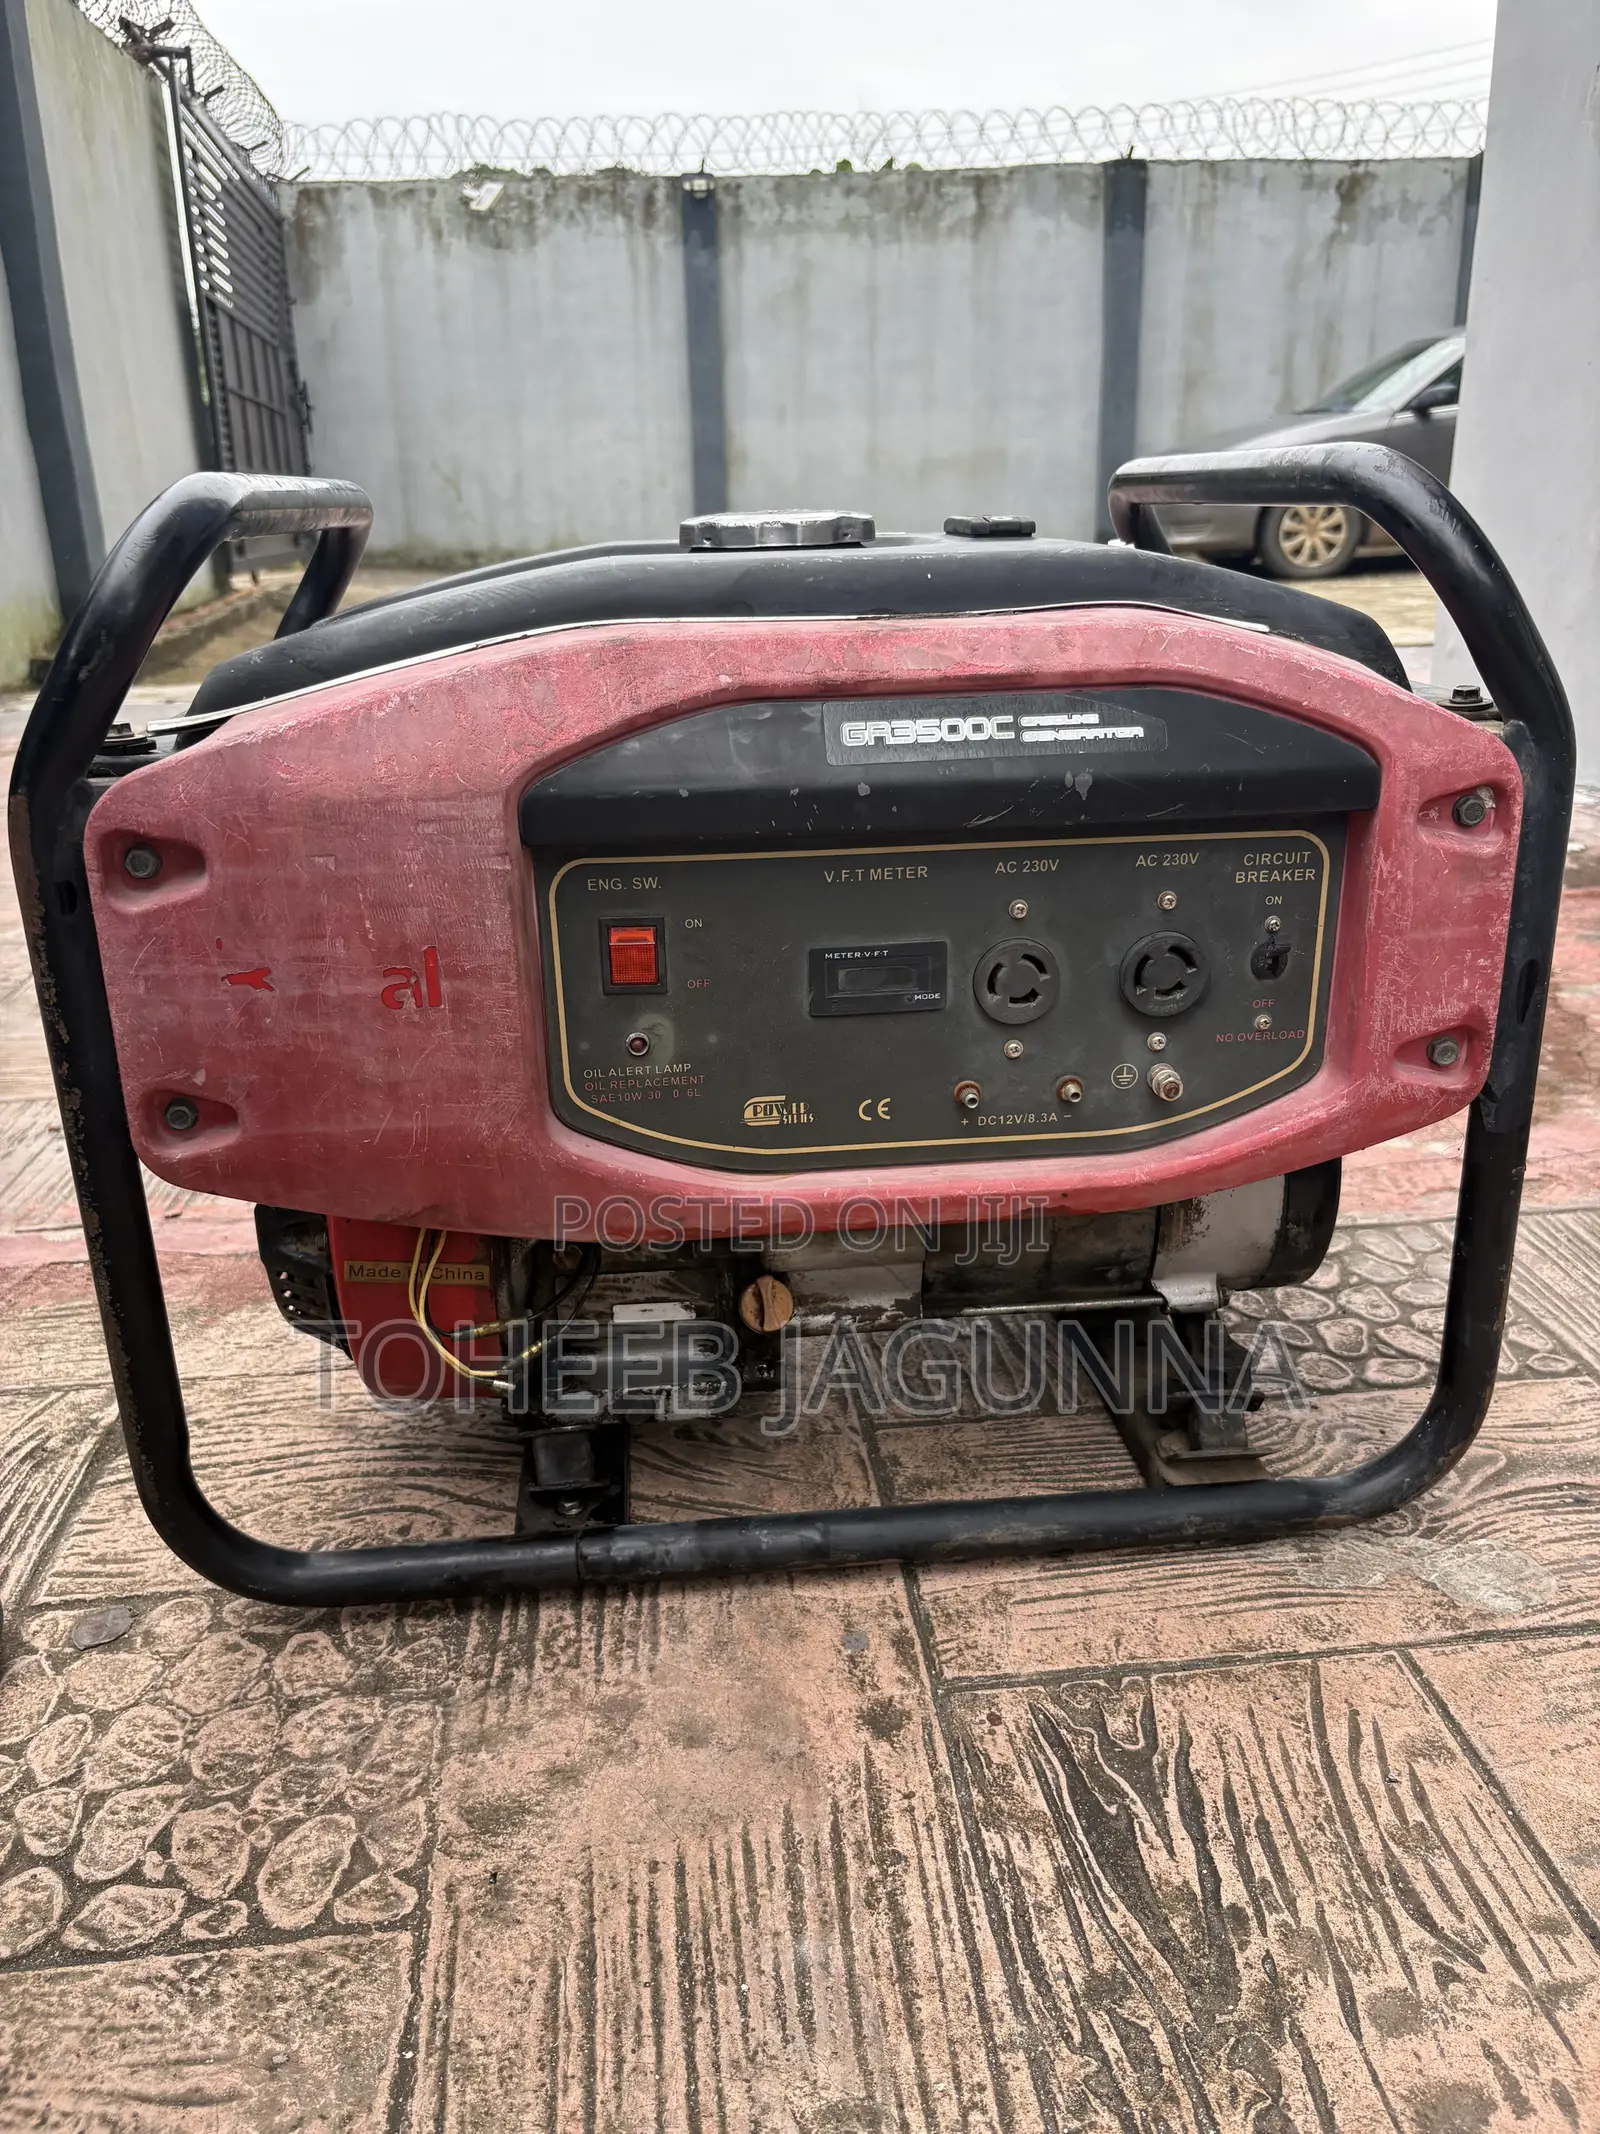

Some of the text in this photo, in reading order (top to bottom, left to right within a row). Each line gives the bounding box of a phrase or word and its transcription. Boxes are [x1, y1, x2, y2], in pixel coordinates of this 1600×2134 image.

[1135, 853, 1200, 868] AC 230V
[1243, 851, 1312, 867] CIRCUIT
[995, 859, 1060, 874] AC 230V
[824, 866, 928, 883] V.F.T METER
[1235, 869, 1316, 884] BREAKER
[587, 877, 662, 891] ENG. SW.
[1265, 896, 1283, 905] ON
[685, 919, 703, 928] ON
[687, 979, 710, 989] OFF
[914, 993, 941, 1001] MODE
[1252, 999, 1275, 1009] OFF
[1216, 1029, 1305, 1043] NO OVERLOAD
[583, 1063, 693, 1079] OIL ALERT LAMP
[585, 1075, 706, 1092] OIL REPLACEMENT
[978, 1112, 1058, 1126] DC12V/8.3A
[349, 1265, 401, 1279] Made
[430, 1268, 485, 1281] China
